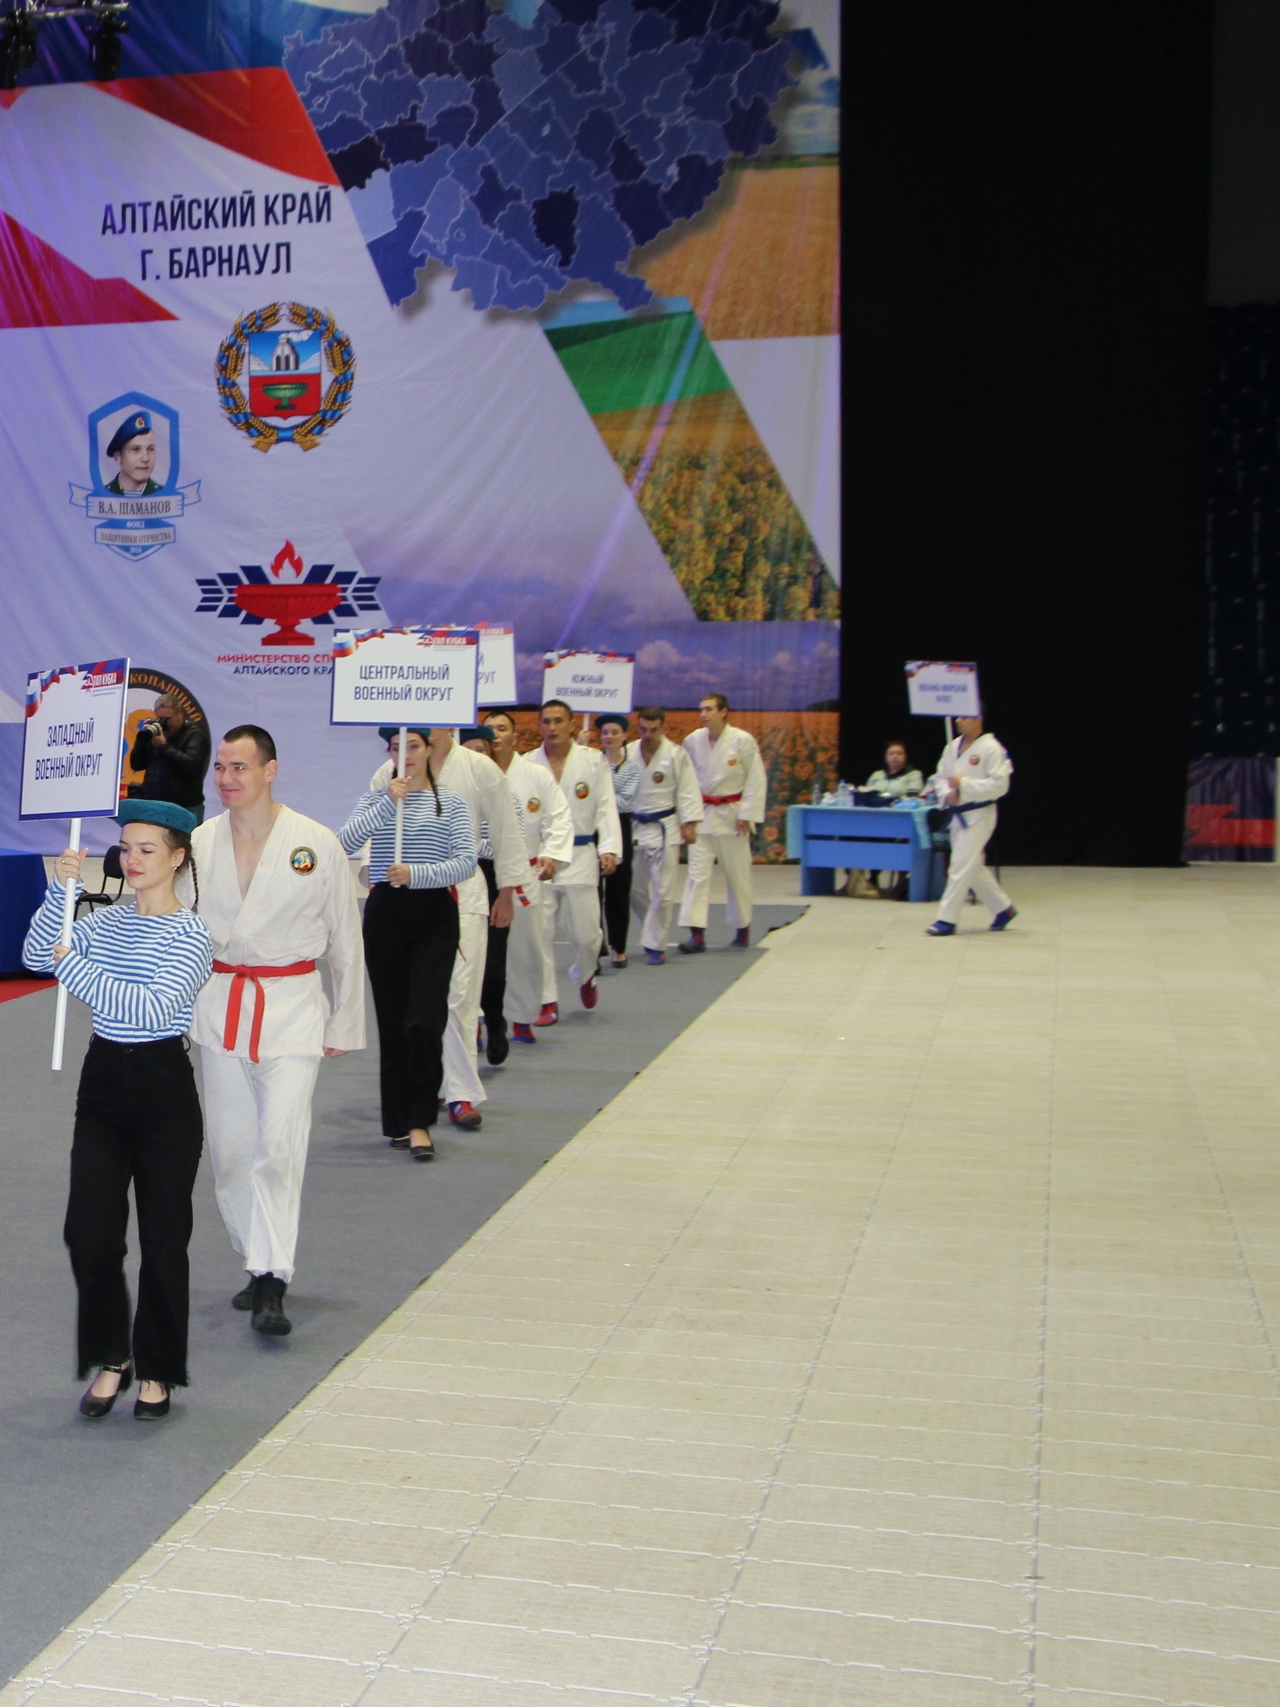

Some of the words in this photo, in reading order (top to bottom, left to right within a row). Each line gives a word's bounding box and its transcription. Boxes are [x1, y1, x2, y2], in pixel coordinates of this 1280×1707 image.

[101, 190, 255, 235] АЛТАЙСКИЙ
[264, 186, 332, 226] КРАЙ
[140, 249, 161, 281] Г.
[169, 242, 292, 280] БАРНАУЛ
[120, 501, 171, 515] ШАМАНОВ
[217, 653, 311, 665] МИНИСТЕРСТВО
[233, 663, 310, 676] АЛТАЙСКОГО
[359, 663, 450, 681] ЦЕНТРАЛЬНЫЙ
[572, 673, 604, 684] ЮЖНЫЙ
[354, 684, 412, 701] ВОЕННЫЙ
[415, 686, 455, 702] ОКРУГ
[556, 686, 593, 697] ВОЕННЫЙ
[594, 688, 619, 698] ОКРУГ
[47, 717, 95, 748] ЗАПАДНЫЙ
[35, 752, 74, 781] ВОЕННЫЙ
[75, 753, 103, 779] ОКРУГ
